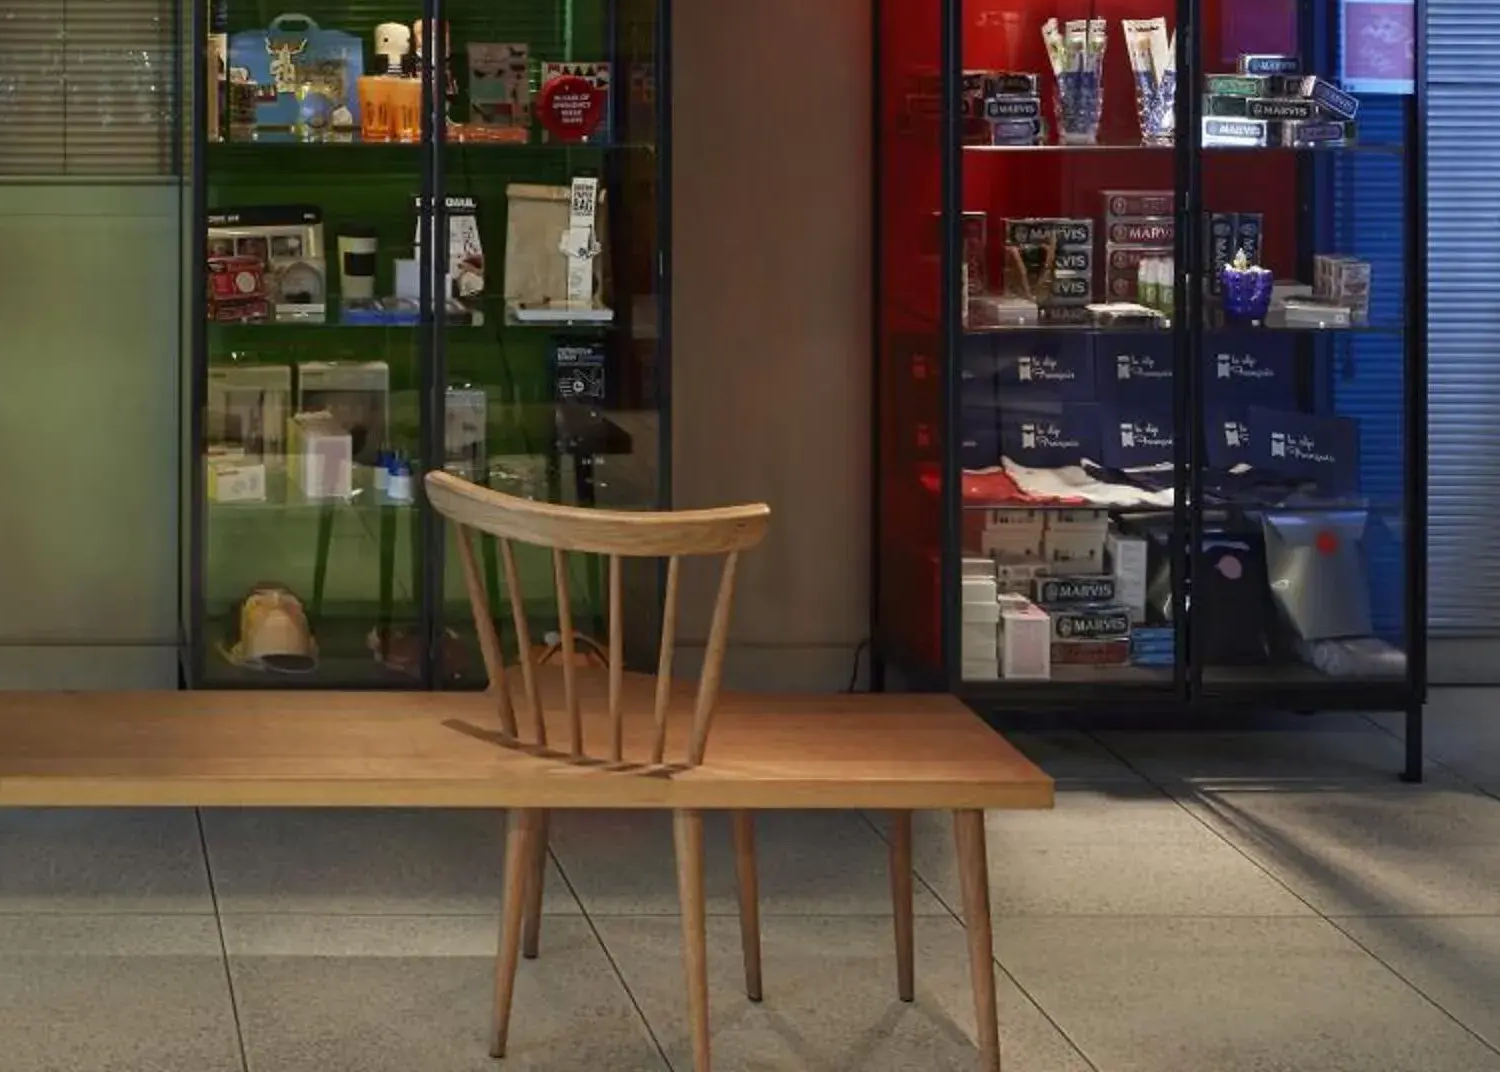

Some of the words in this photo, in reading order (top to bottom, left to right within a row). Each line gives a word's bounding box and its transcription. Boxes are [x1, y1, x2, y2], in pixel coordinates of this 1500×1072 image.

[1263, 105, 1310, 117] MARVIS
[1129, 227, 1173, 240] MARV
[1059, 584, 1112, 597] MARVIS
[1073, 617, 1126, 632] MARVIS
